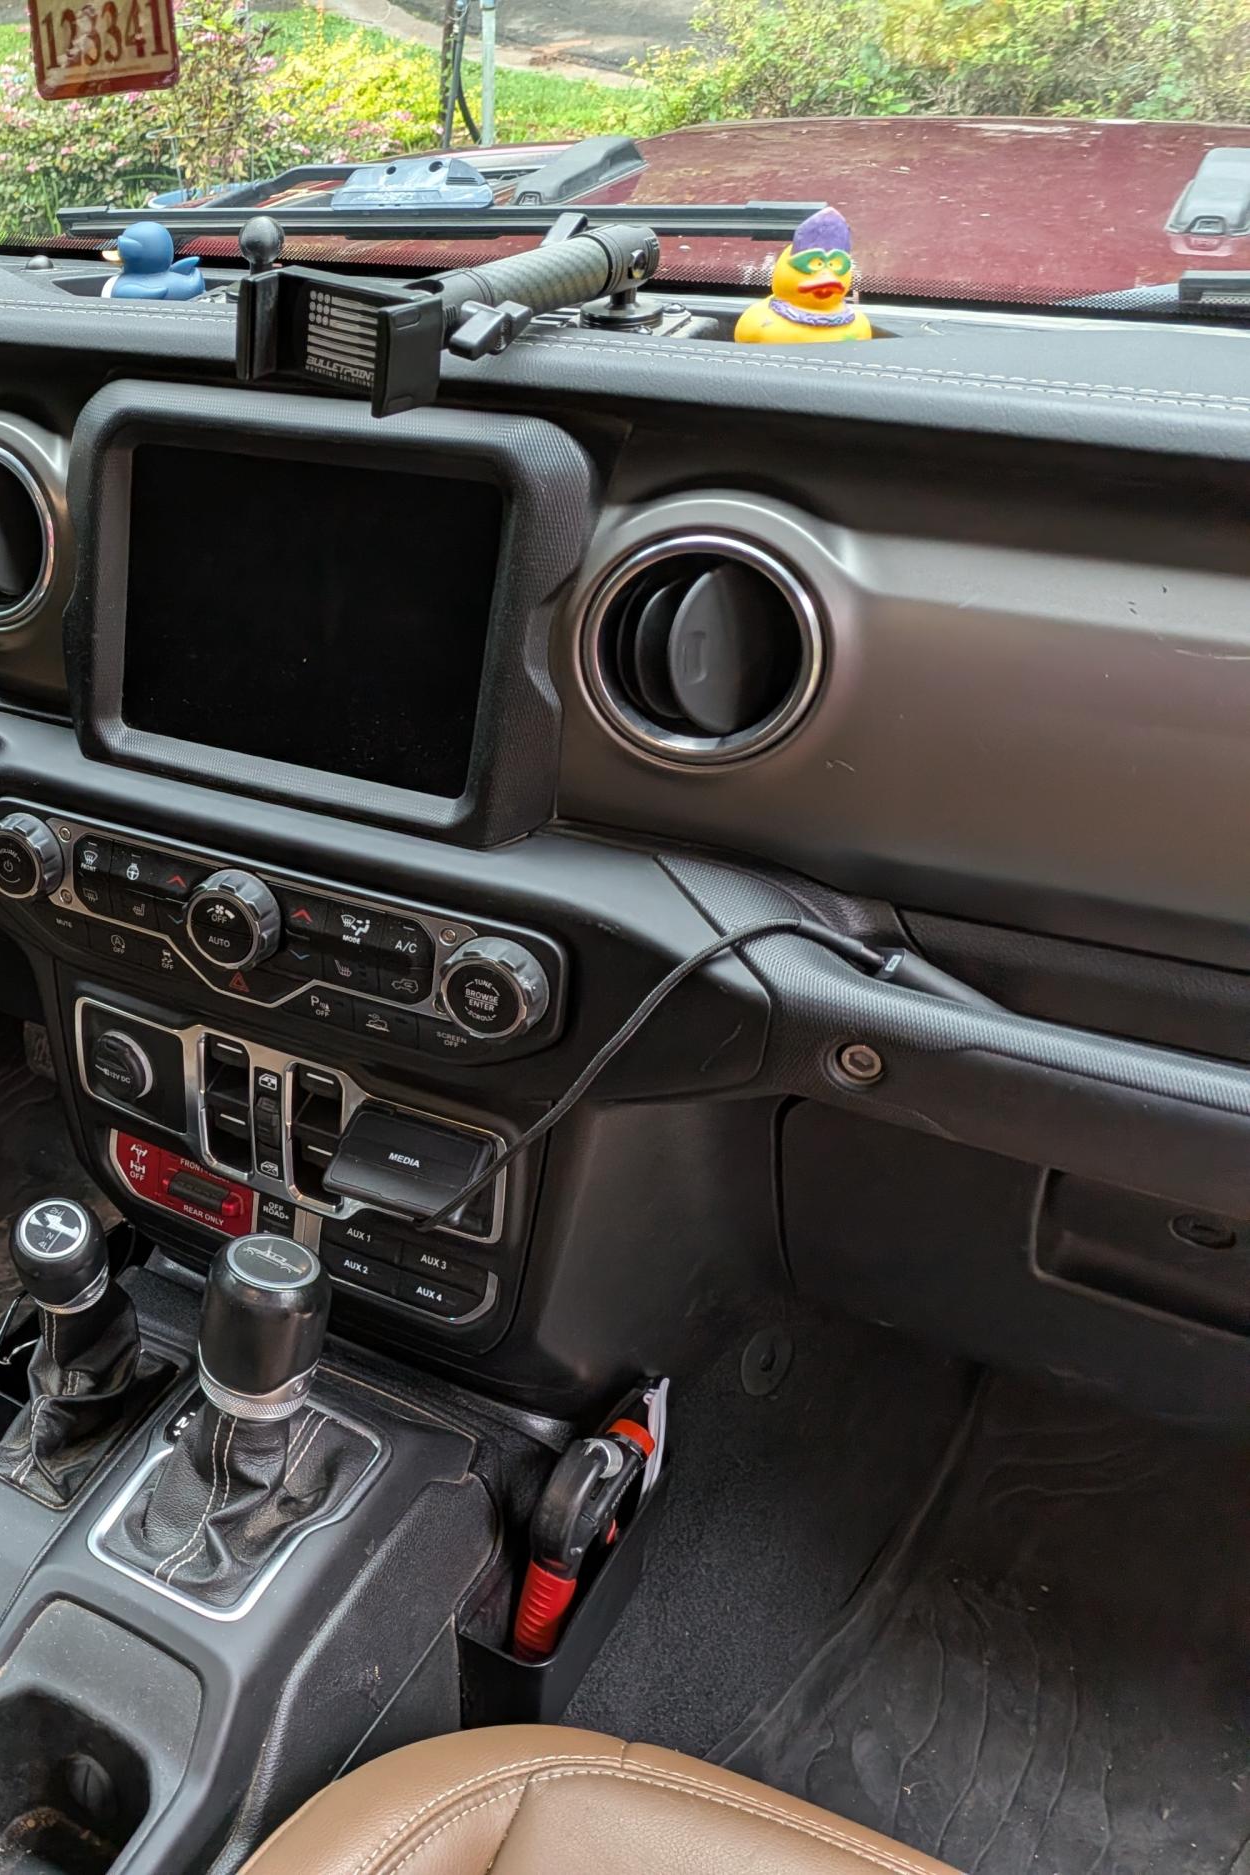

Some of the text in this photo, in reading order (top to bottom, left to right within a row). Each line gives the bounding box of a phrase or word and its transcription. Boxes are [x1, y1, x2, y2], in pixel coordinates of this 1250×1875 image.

[80, 862, 97, 872] FRONT
[211, 913, 228, 924] OFF
[208, 935, 230, 948] AUTO
[342, 934, 361, 945] MODE
[395, 940, 417, 953] A/C
[161, 962, 174, 970] OFF
[474, 979, 493, 989] TUNE
[465, 988, 499, 1003] BROWSE
[469, 998, 495, 1012] ENTER
[315, 1008, 331, 1018] OFF
[467, 1010, 494, 1022] SCROLL
[436, 1031, 467, 1044] SCREEN
[444, 1039, 459, 1048] OFF
[388, 1152, 421, 1168] MEDIA
[130, 1169, 145, 1181] OFF
[268, 1202, 284, 1212] OFF
[183, 1204, 225, 1226] REAR ONLY
[346, 1227, 365, 1241] AUX
[344, 1259, 369, 1274] AUX 2
[420, 1254, 447, 1270] AUX 3
[416, 1286, 443, 1302] AUX 4
